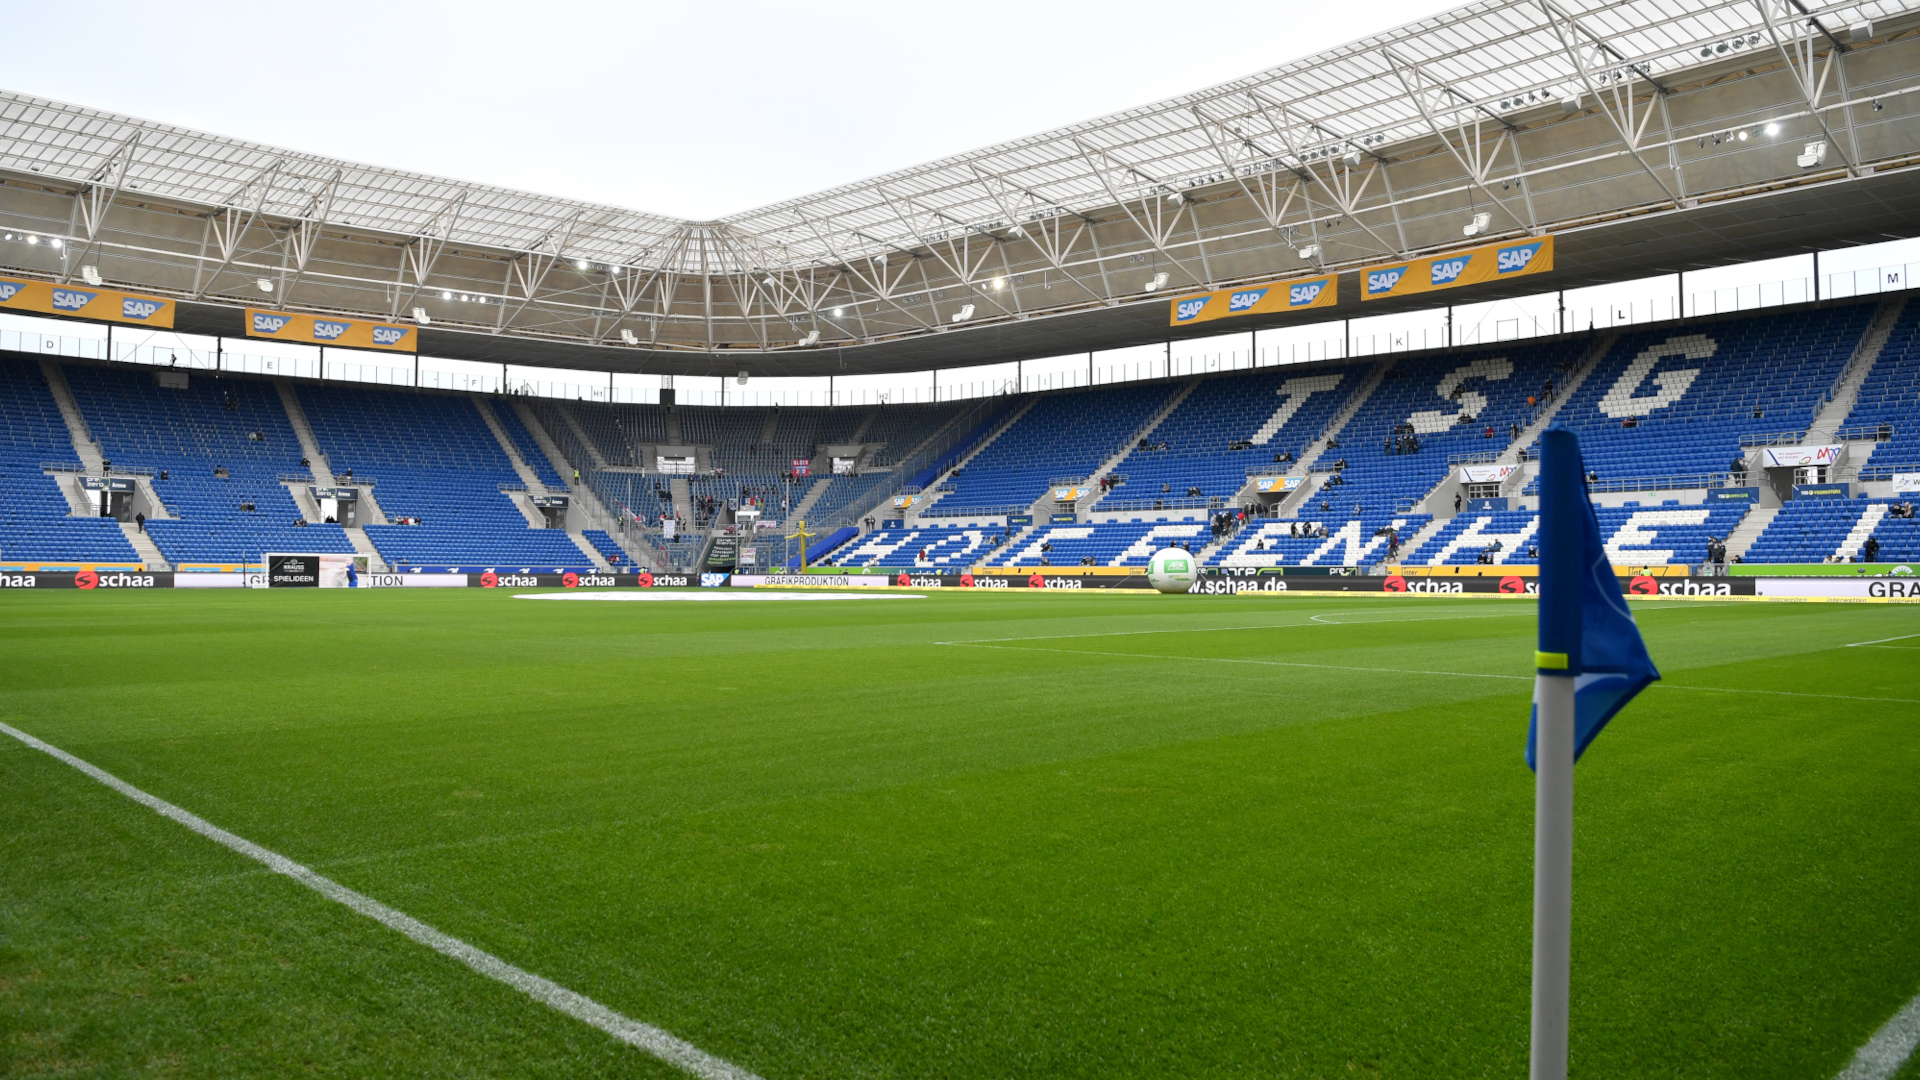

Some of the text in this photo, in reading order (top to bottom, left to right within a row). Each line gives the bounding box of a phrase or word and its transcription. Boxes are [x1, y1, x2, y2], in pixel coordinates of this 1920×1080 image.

[1498, 249, 1532, 269] SAP
[1432, 262, 1463, 280] SAP
[1368, 272, 1399, 290] SAP
[1888, 273, 1898, 284] M
[53, 292, 88, 308] SAP
[1230, 293, 1260, 308] SAP
[1290, 286, 1320, 302] SAP
[123, 301, 156, 316] SAP
[1178, 301, 1204, 318] SAP
[1618, 310, 1625, 319] L
[254, 316, 284, 330] SAP
[314, 322, 344, 338] SAP
[373, 328, 401, 343] SAP
[1396, 338, 1402, 346] K
[1257, 480, 1273, 490] SAP
[1055, 490, 1067, 499] SAP
[1167, 561, 1186, 570] AOK
[99, 573, 154, 587] schaa
[498, 574, 537, 586] schaa
[578, 575, 615, 586] schaa
[652, 575, 687, 586] schaa
[701, 574, 723, 586] SAP
[764, 576, 849, 586] GRAFIKPRODUKTION
[910, 576, 941, 587] schaa
[974, 577, 1008, 588] schaa
[1044, 577, 1082, 588] schaa
[1406, 578, 1463, 593] schaa
[1659, 579, 1731, 596] schaa
[1868, 582, 1920, 597] GRA
